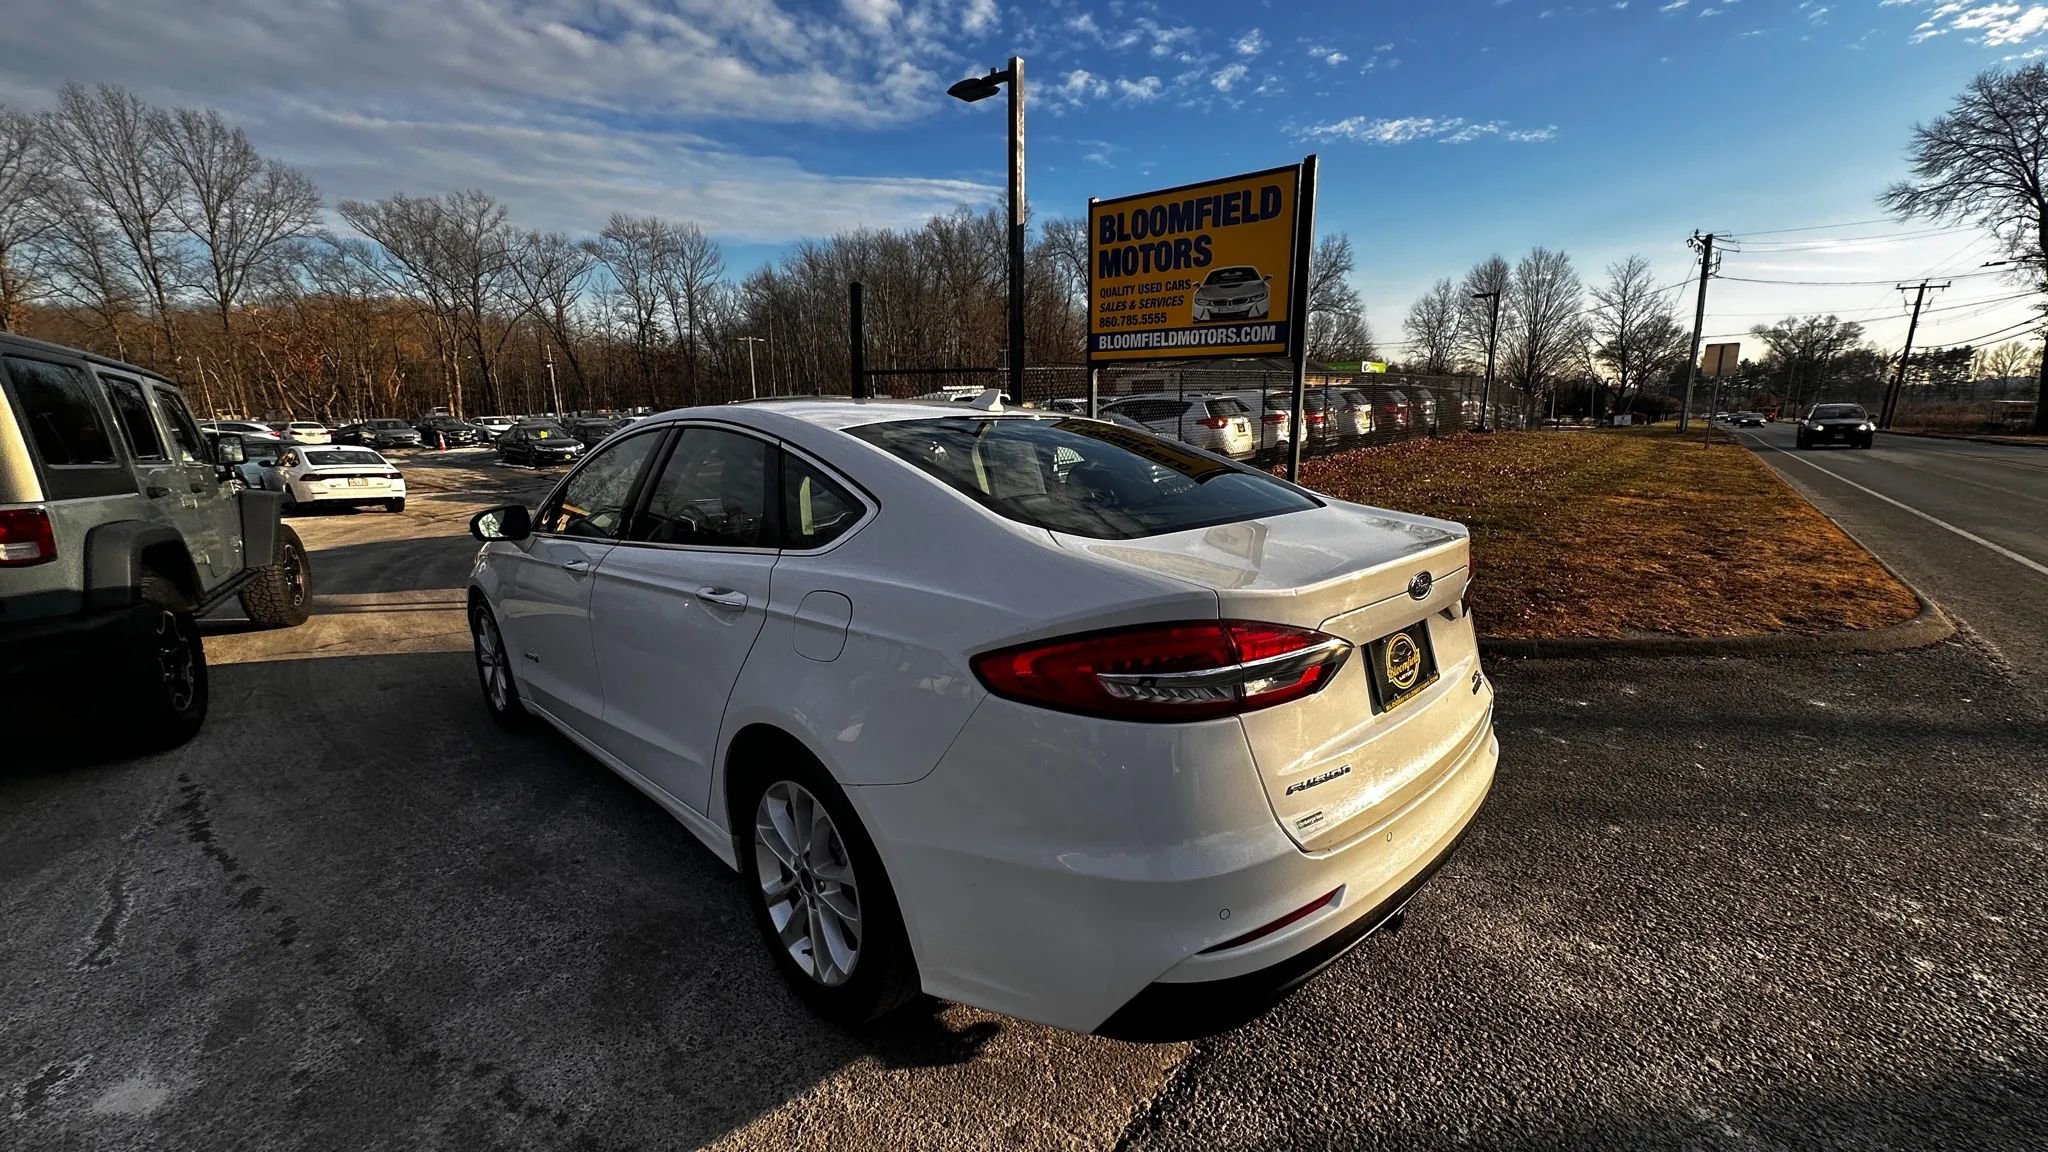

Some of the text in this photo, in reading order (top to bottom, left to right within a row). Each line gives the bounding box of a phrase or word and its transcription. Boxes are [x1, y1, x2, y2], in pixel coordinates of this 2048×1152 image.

[1099, 185, 1282, 245] BLOOMFIELD
[1099, 234, 1213, 279] MOTORS
[1100, 279, 1191, 299] QUALITY USED CARS
[1099, 295, 1185, 313] SALES & SERVICES
[1099, 312, 1168, 328] 860.785.5555
[1099, 325, 1276, 350] BLOOMFIELDMOTORS.COM
